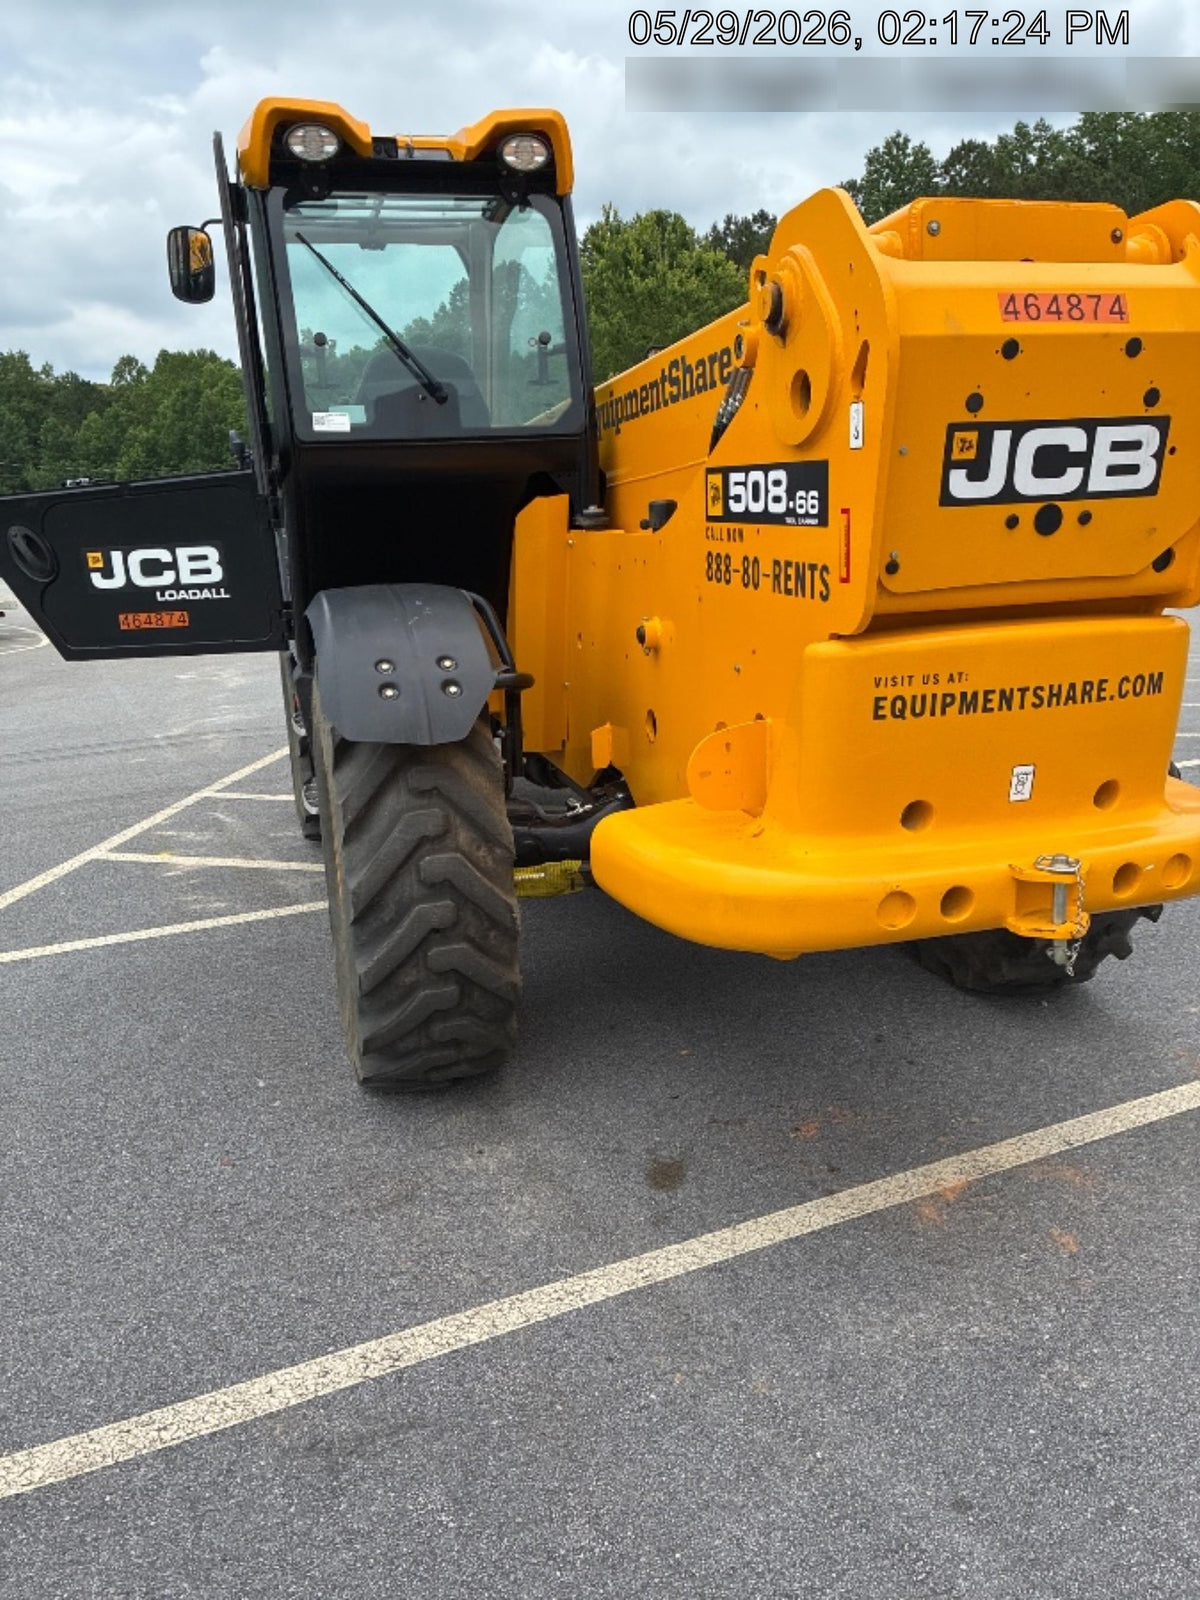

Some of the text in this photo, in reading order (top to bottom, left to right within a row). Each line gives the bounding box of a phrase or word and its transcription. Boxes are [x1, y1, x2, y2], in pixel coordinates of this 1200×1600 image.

[1003, 292, 1126, 321] 464874
[596, 346, 733, 441] quipmentShare
[948, 424, 1161, 499] JCB
[89, 545, 224, 589] JCB
[705, 550, 831, 603] 888-80-RENTS
[155, 587, 230, 602] LOADALL
[121, 612, 187, 629] 464874
[872, 671, 1165, 721] EQUIPMENTSHARE.COM
[873, 671, 969, 689] VISIT US AT:
